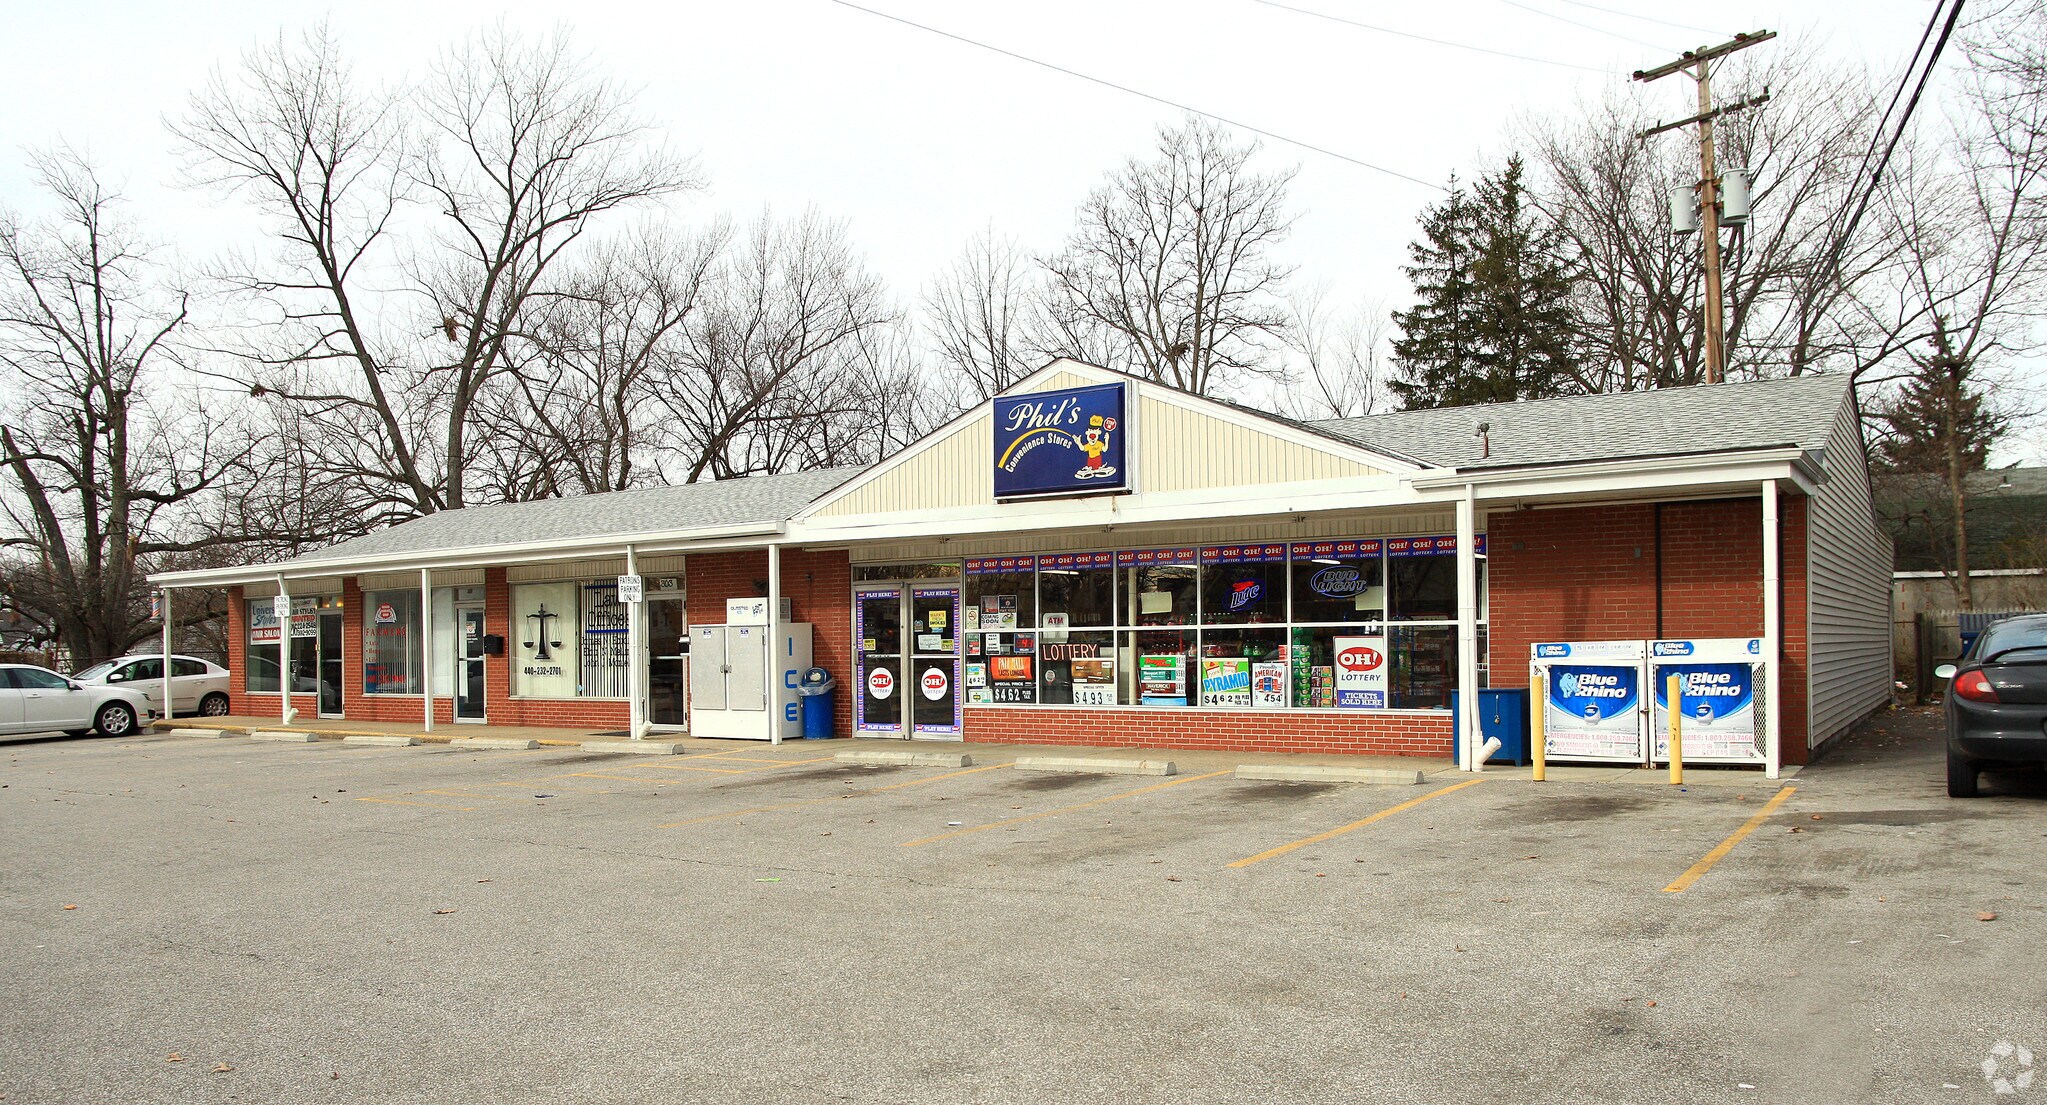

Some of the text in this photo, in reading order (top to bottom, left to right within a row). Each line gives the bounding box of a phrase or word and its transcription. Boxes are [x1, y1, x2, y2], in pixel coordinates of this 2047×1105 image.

[1004, 397, 1081, 432] Phil's
[1005, 432, 1072, 473] Convenience Stores
[1293, 542, 1378, 553] OH! OH! OH! OH!
[1389, 539, 1455, 550] OH! OH! OH!
[1138, 552, 1153, 560] OH!
[1157, 551, 1173, 559] OH!
[1177, 550, 1193, 558] OH!
[1202, 547, 1282, 557] OH! OH! OH! OH!
[1001, 559, 1015, 567] OH!
[1018, 558, 1032, 566] OH!
[1040, 554, 1110, 565] OH! OH! OH! OH!
[619, 576, 640, 584] PATRONS
[1323, 570, 1359, 582] BUD
[620, 585, 640, 593] PARKING
[1317, 579, 1366, 593] LIGHT
[252, 614, 276, 627] Styles
[1048, 617, 1064, 625] ATM
[1043, 644, 1097, 661] LOTTERY
[1340, 651, 1378, 666] OH!
[524, 666, 562, 676] 440-232-2701
[1255, 669, 1282, 678] AMERICAN
[870, 676, 890, 685] OH!
[924, 678, 943, 686] OH!
[1203, 671, 1249, 693] PYRAMID
[1579, 674, 1618, 686] Blue
[1689, 672, 1731, 684] Blue
[1575, 687, 1627, 698] Rhino
[1685, 685, 1741, 697] Rhino
